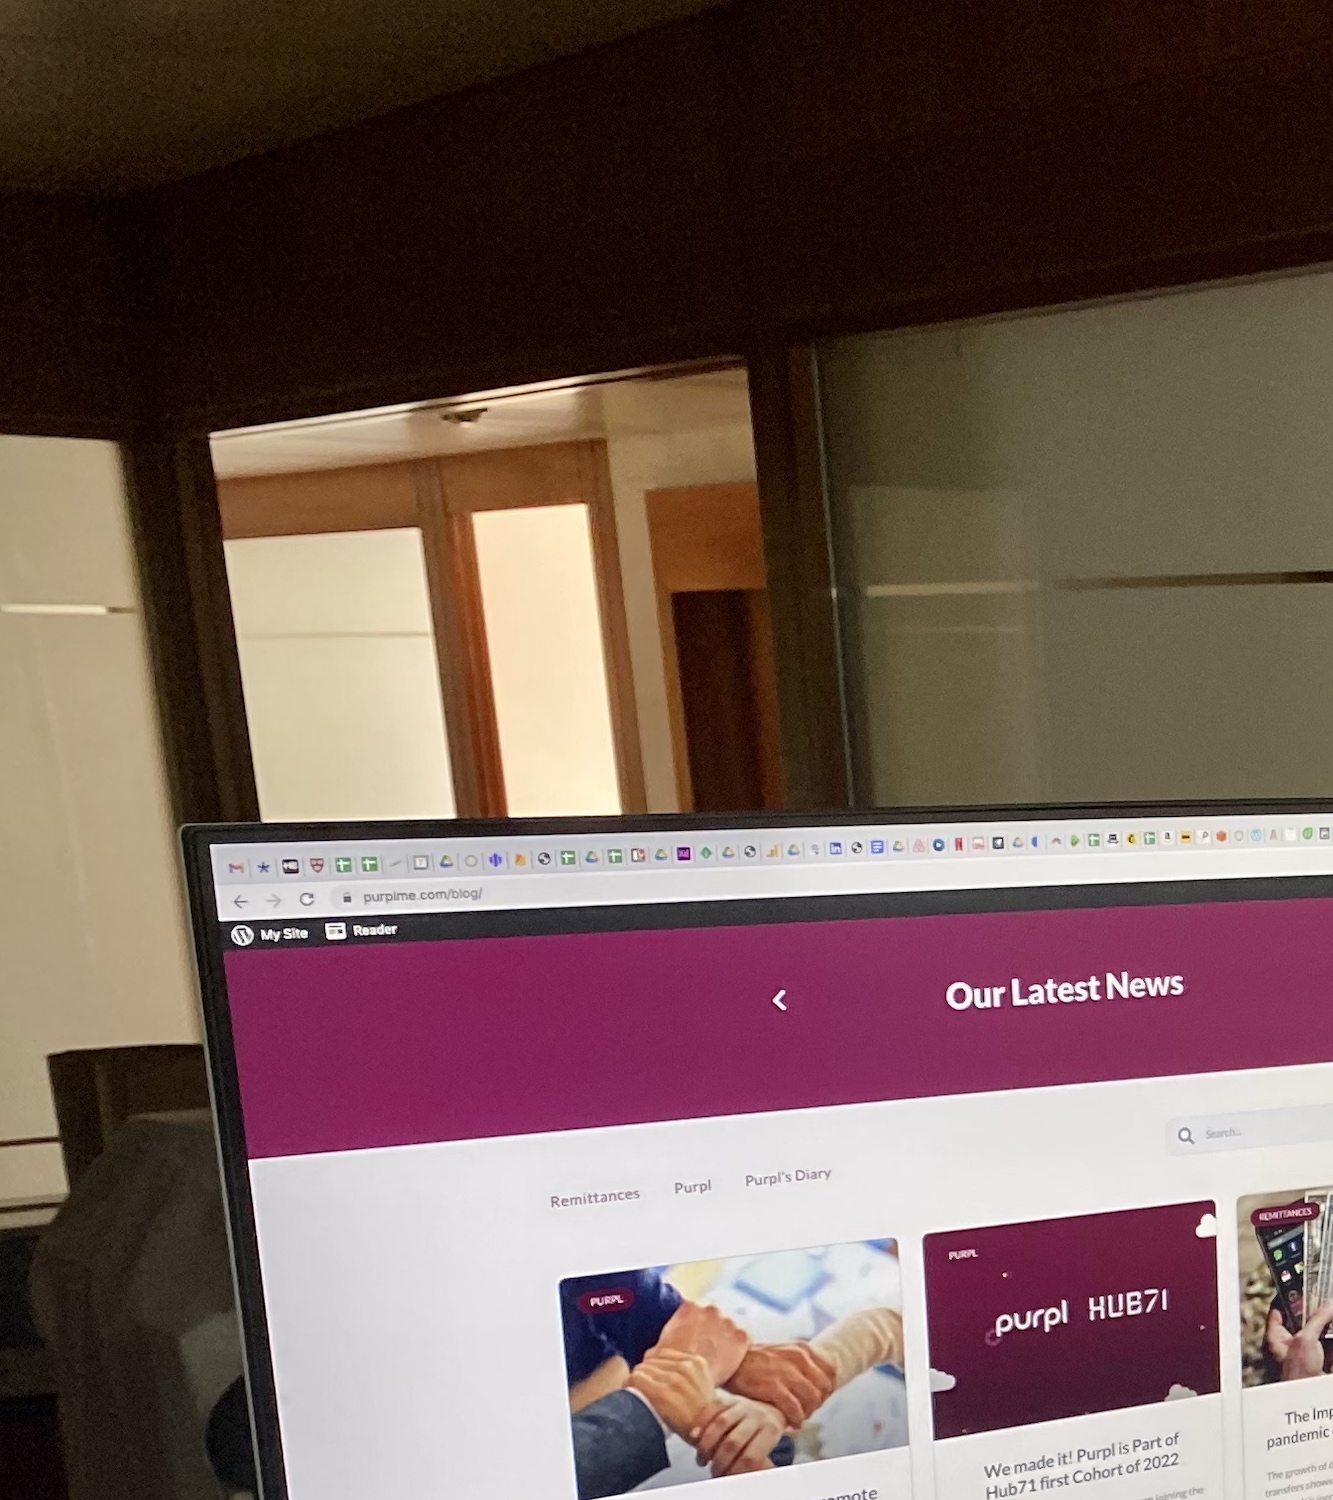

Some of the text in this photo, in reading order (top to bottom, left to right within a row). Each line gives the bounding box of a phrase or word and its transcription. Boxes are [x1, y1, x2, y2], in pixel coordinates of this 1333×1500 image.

[260, 926, 308, 942] My Site
[353, 924, 398, 937] Reader
[946, 970, 1184, 1012] Our Latest News
[746, 1168, 832, 1187] Purpl's Diary
[674, 1180, 712, 1195] Purpl
[550, 1188, 640, 1208] Remittances
[1258, 1207, 1312, 1222] REMITTANCES
[949, 1248, 978, 1260] PURPL
[590, 1294, 624, 1306] PURPL
[1088, 1288, 1168, 1321] HUB71
[990, 1300, 1069, 1340] purpl
[1285, 1412, 1309, 1424] The
[1267, 1429, 1329, 1449] pandemic
[984, 1433, 1179, 1478] We made it! Purpl is Part of
[986, 1454, 1178, 1499] Hub71 first Cohort of 2022
[1266, 1472, 1283, 1480] The
[1285, 1465, 1316, 1478] growth
[1318, 1462, 1326, 1470] of
